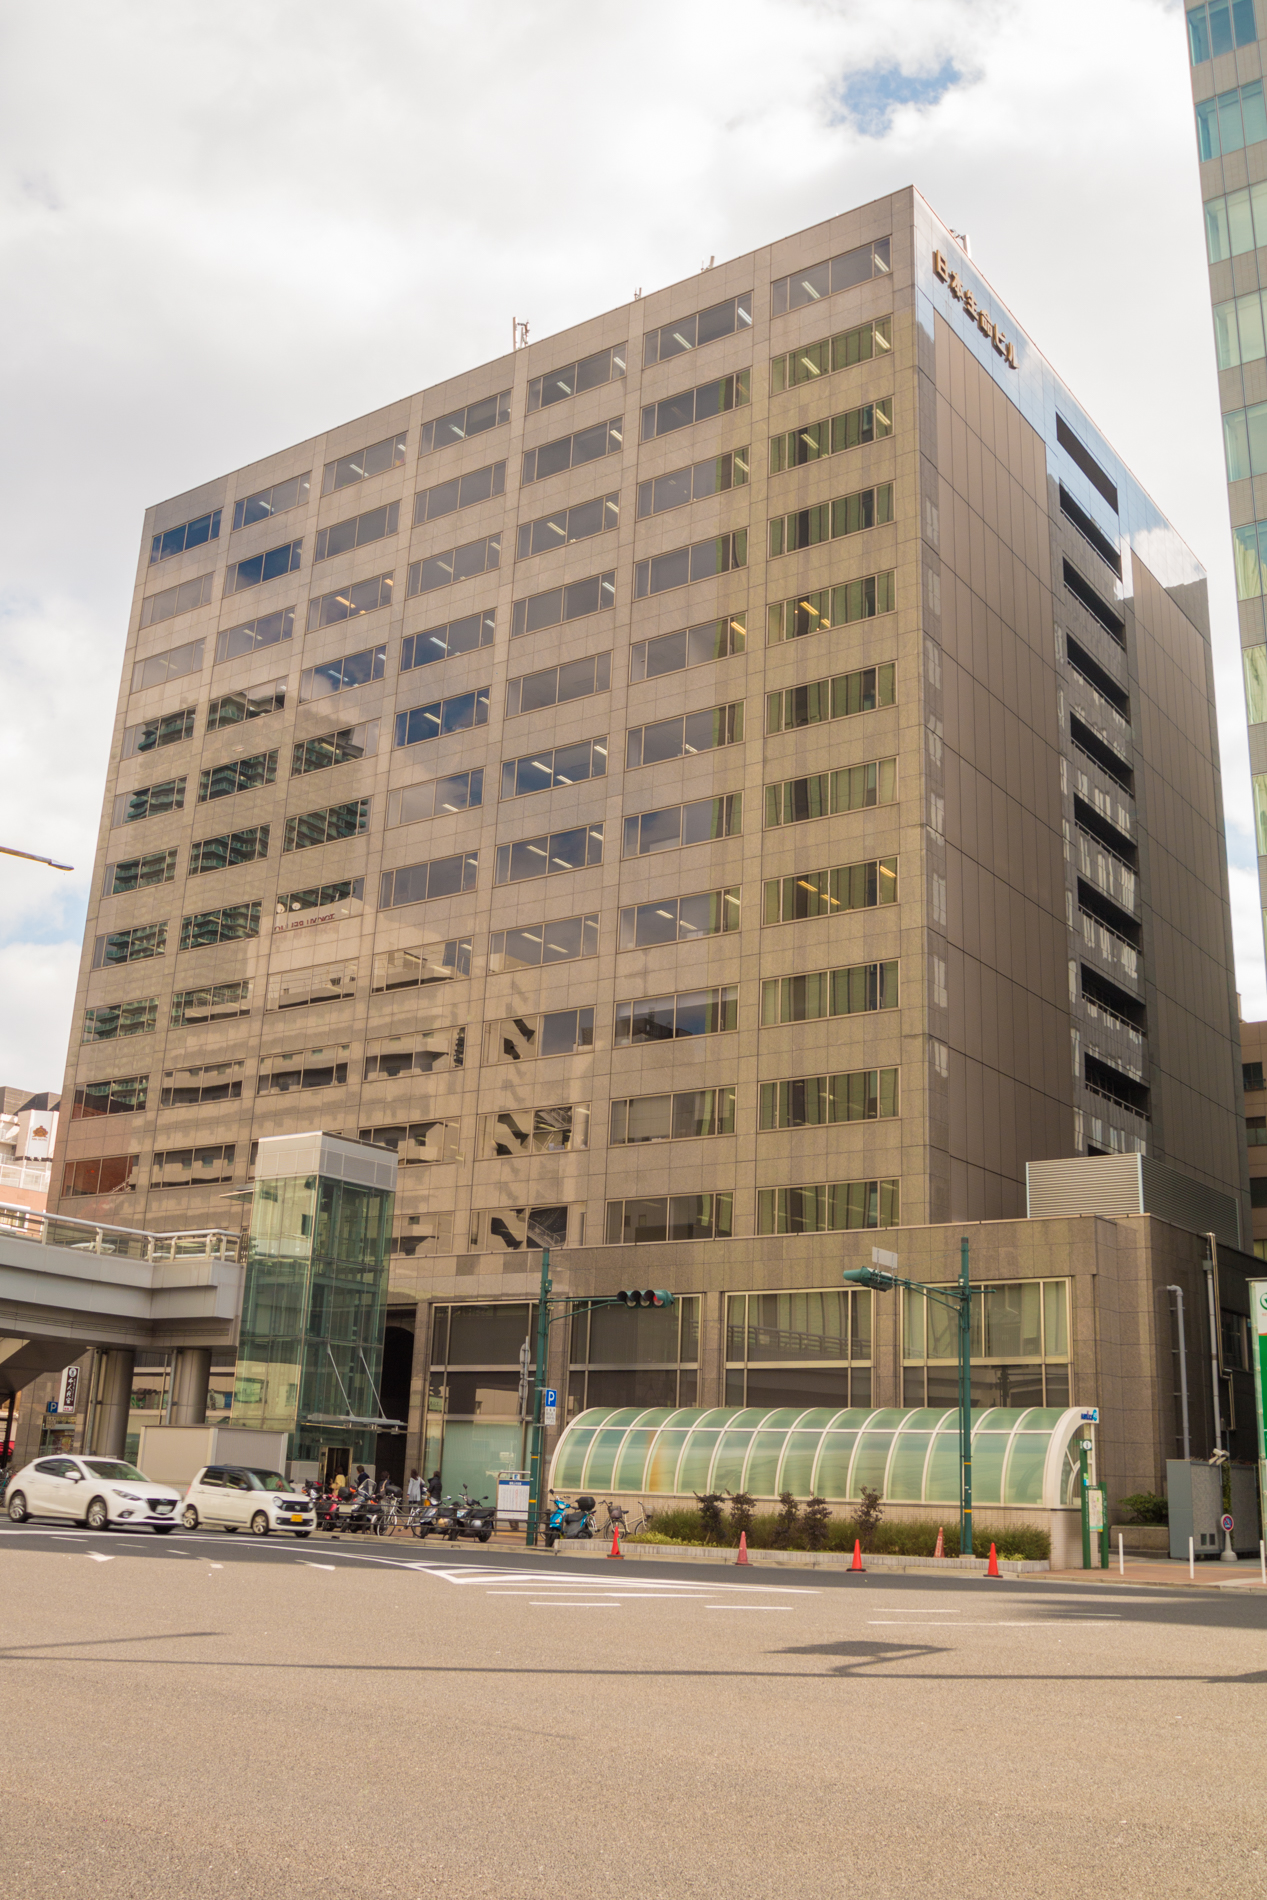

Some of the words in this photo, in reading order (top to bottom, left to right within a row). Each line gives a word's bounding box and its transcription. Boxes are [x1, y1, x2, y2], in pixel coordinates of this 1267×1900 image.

[933, 249, 1020, 369] 日本生命ビル
[547, 1391, 555, 1405] P
[50, 1402, 56, 1411] P
